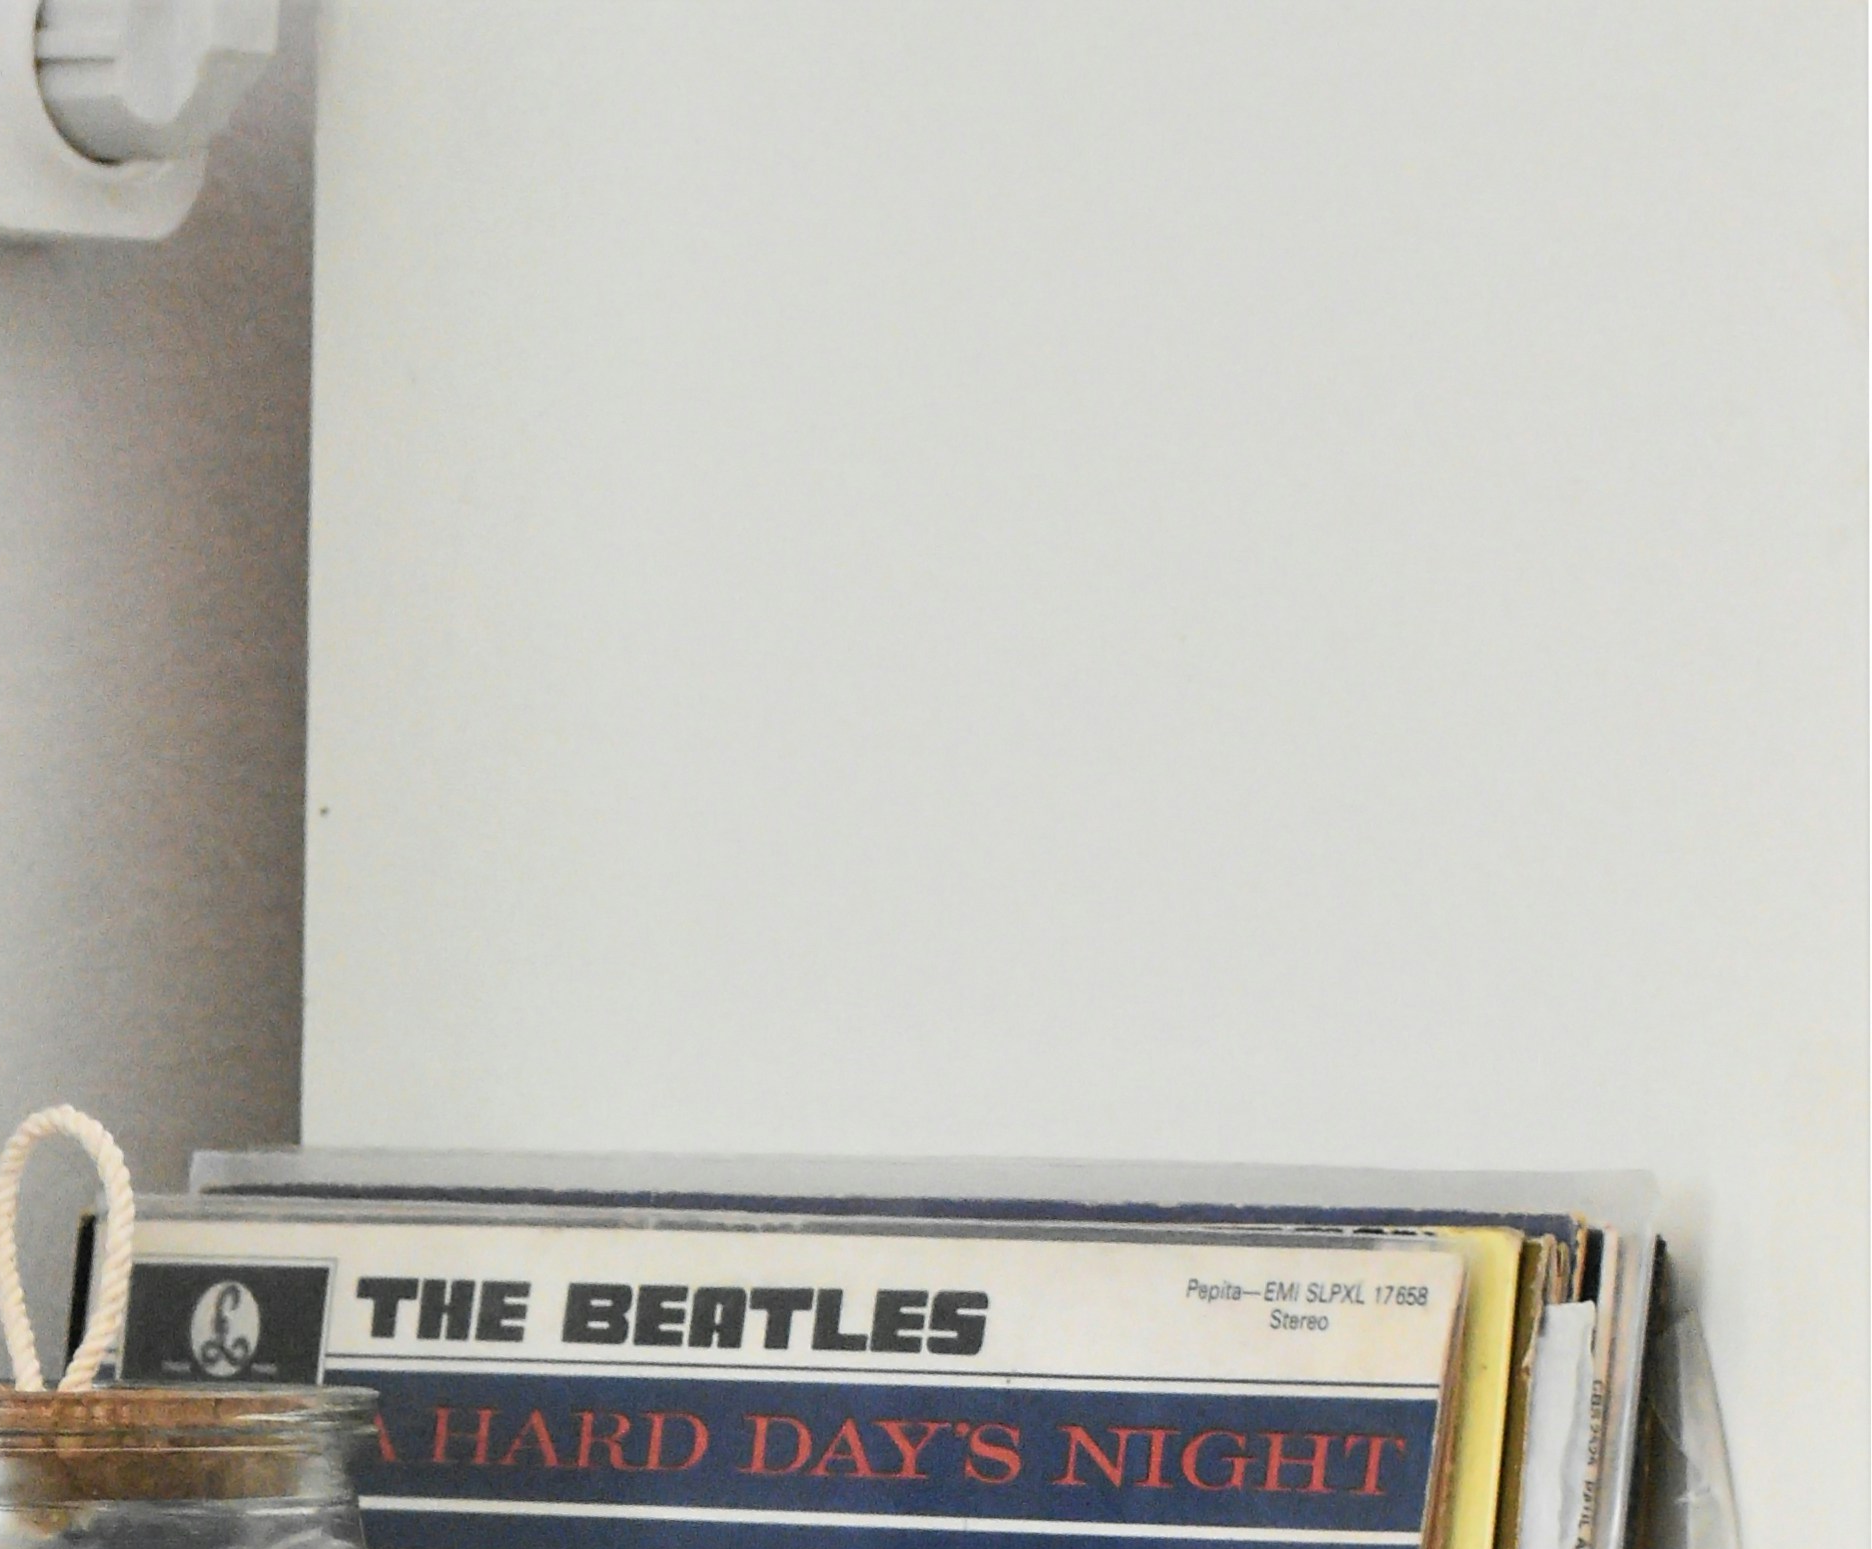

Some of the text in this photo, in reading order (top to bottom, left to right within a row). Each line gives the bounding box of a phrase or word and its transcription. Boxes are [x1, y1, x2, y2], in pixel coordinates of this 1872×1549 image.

[356, 1276, 989, 1354] THE BEATLES
[1305, 1282, 1366, 1305] SLPXL
[1269, 1308, 1330, 1333] Stereo
[431, 1405, 711, 1472] HARD
[737, 1412, 1023, 1483] DAY'S
[1052, 1423, 1408, 1495] NIGHT
